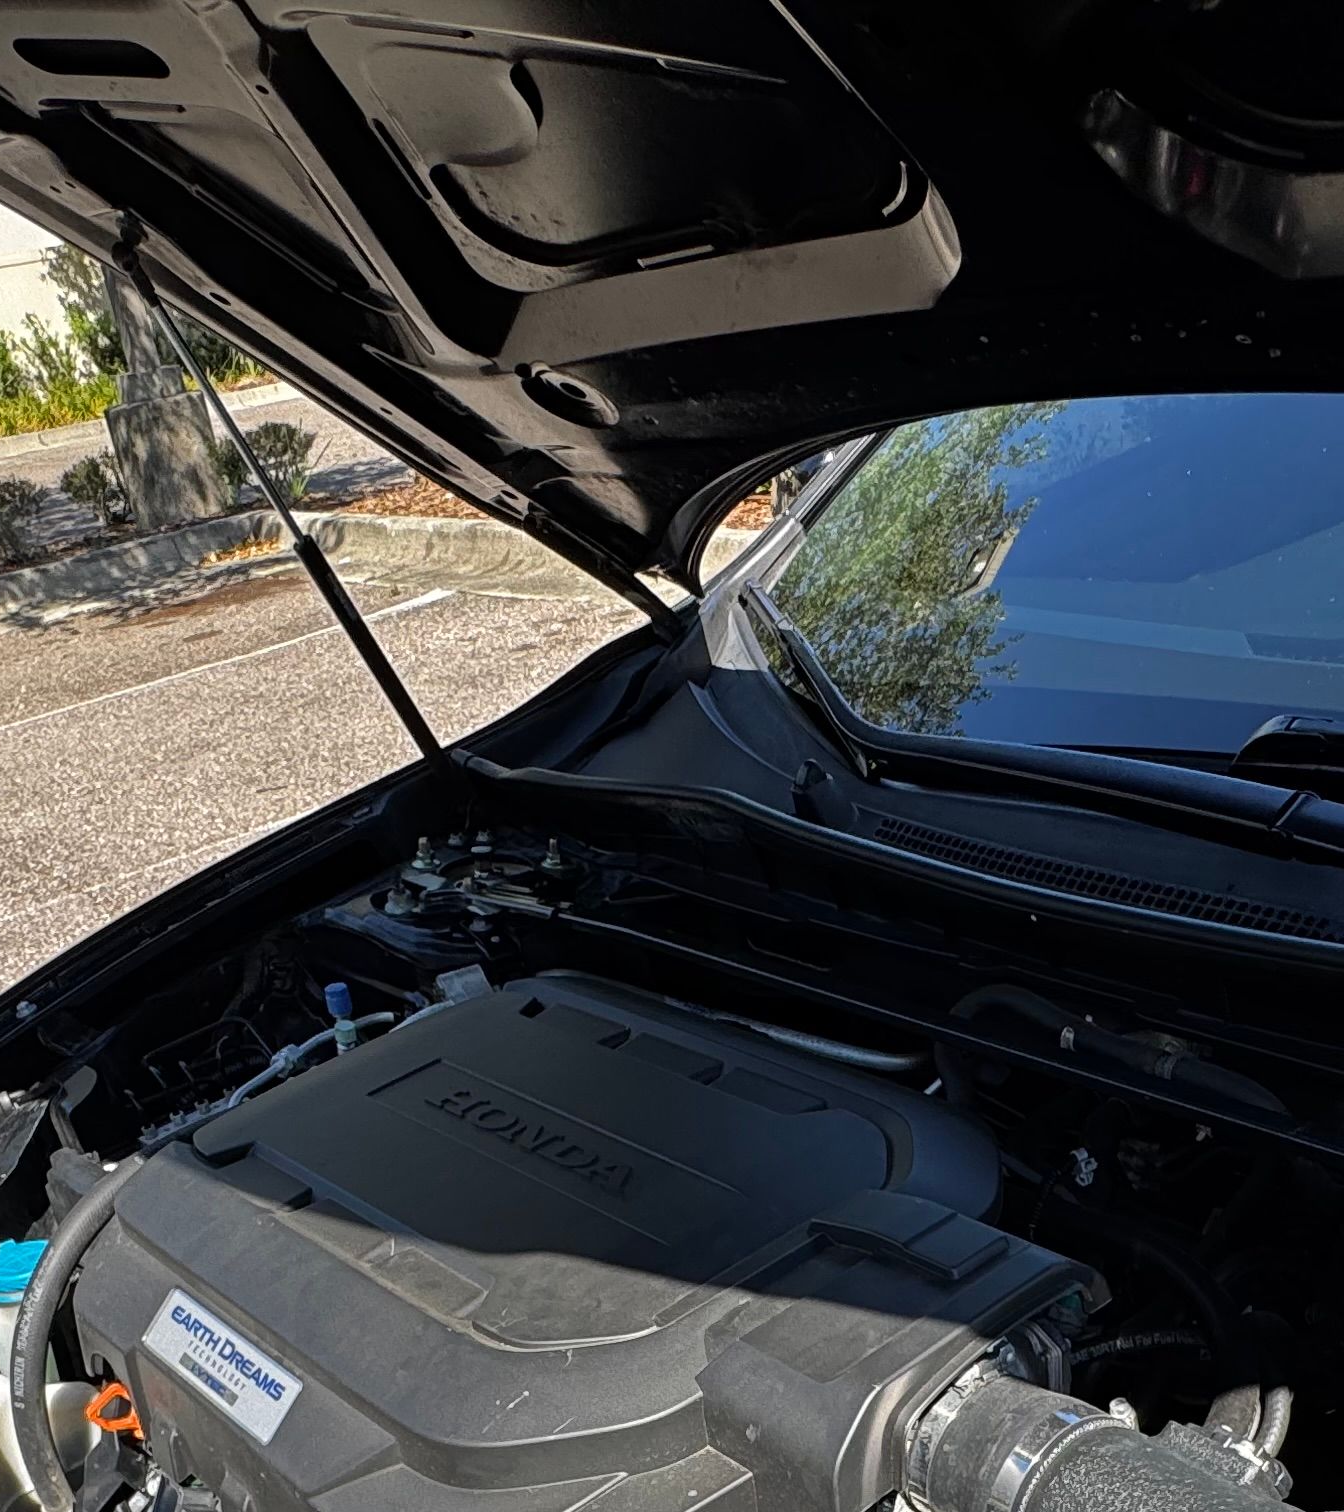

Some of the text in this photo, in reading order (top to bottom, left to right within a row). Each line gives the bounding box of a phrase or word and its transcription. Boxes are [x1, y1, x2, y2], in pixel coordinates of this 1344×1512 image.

[425, 1086, 637, 1197] HONDA
[170, 1304, 288, 1403] EARTH DREAMS
[187, 1339, 248, 1392] TECHNOLOGY
